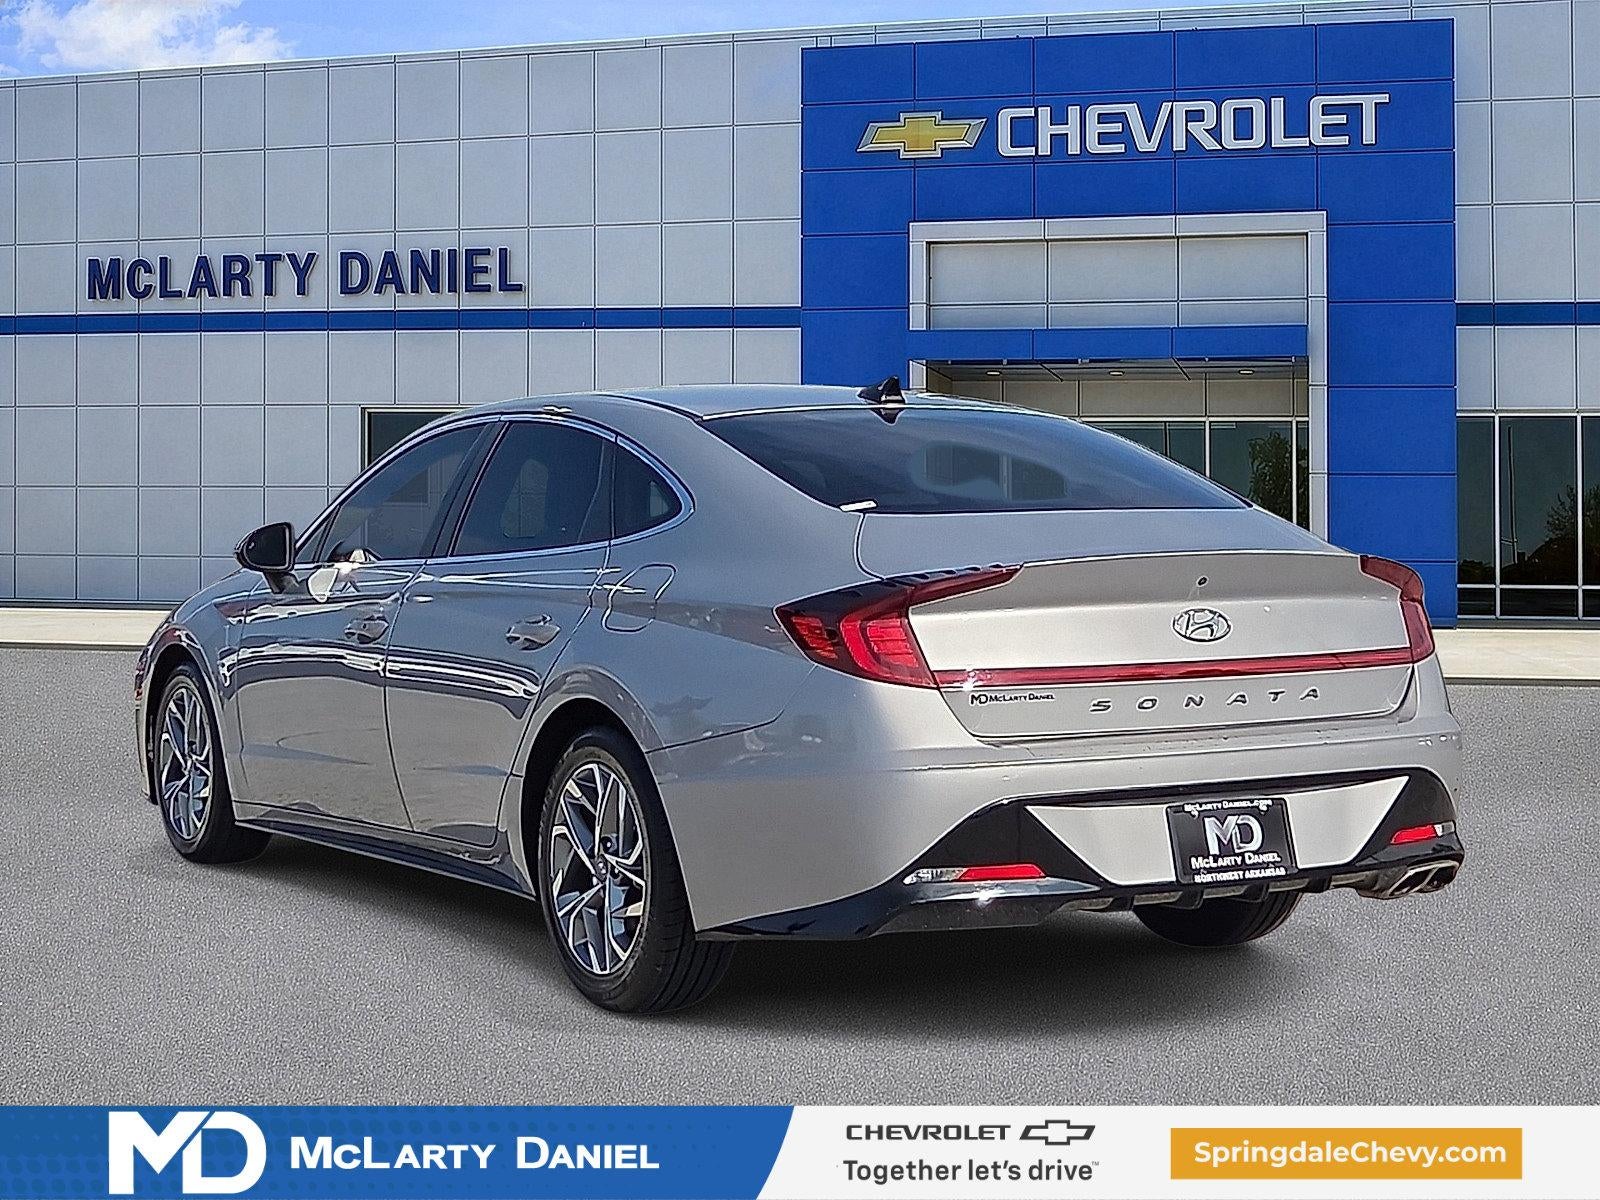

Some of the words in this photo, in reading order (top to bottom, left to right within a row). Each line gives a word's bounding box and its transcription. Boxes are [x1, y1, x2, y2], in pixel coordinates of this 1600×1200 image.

[997, 93, 1390, 157] CHEVROLET
[338, 247, 524, 296] DANIEL
[1089, 688, 1320, 712] SONATA
[1204, 814, 1263, 855] MD
